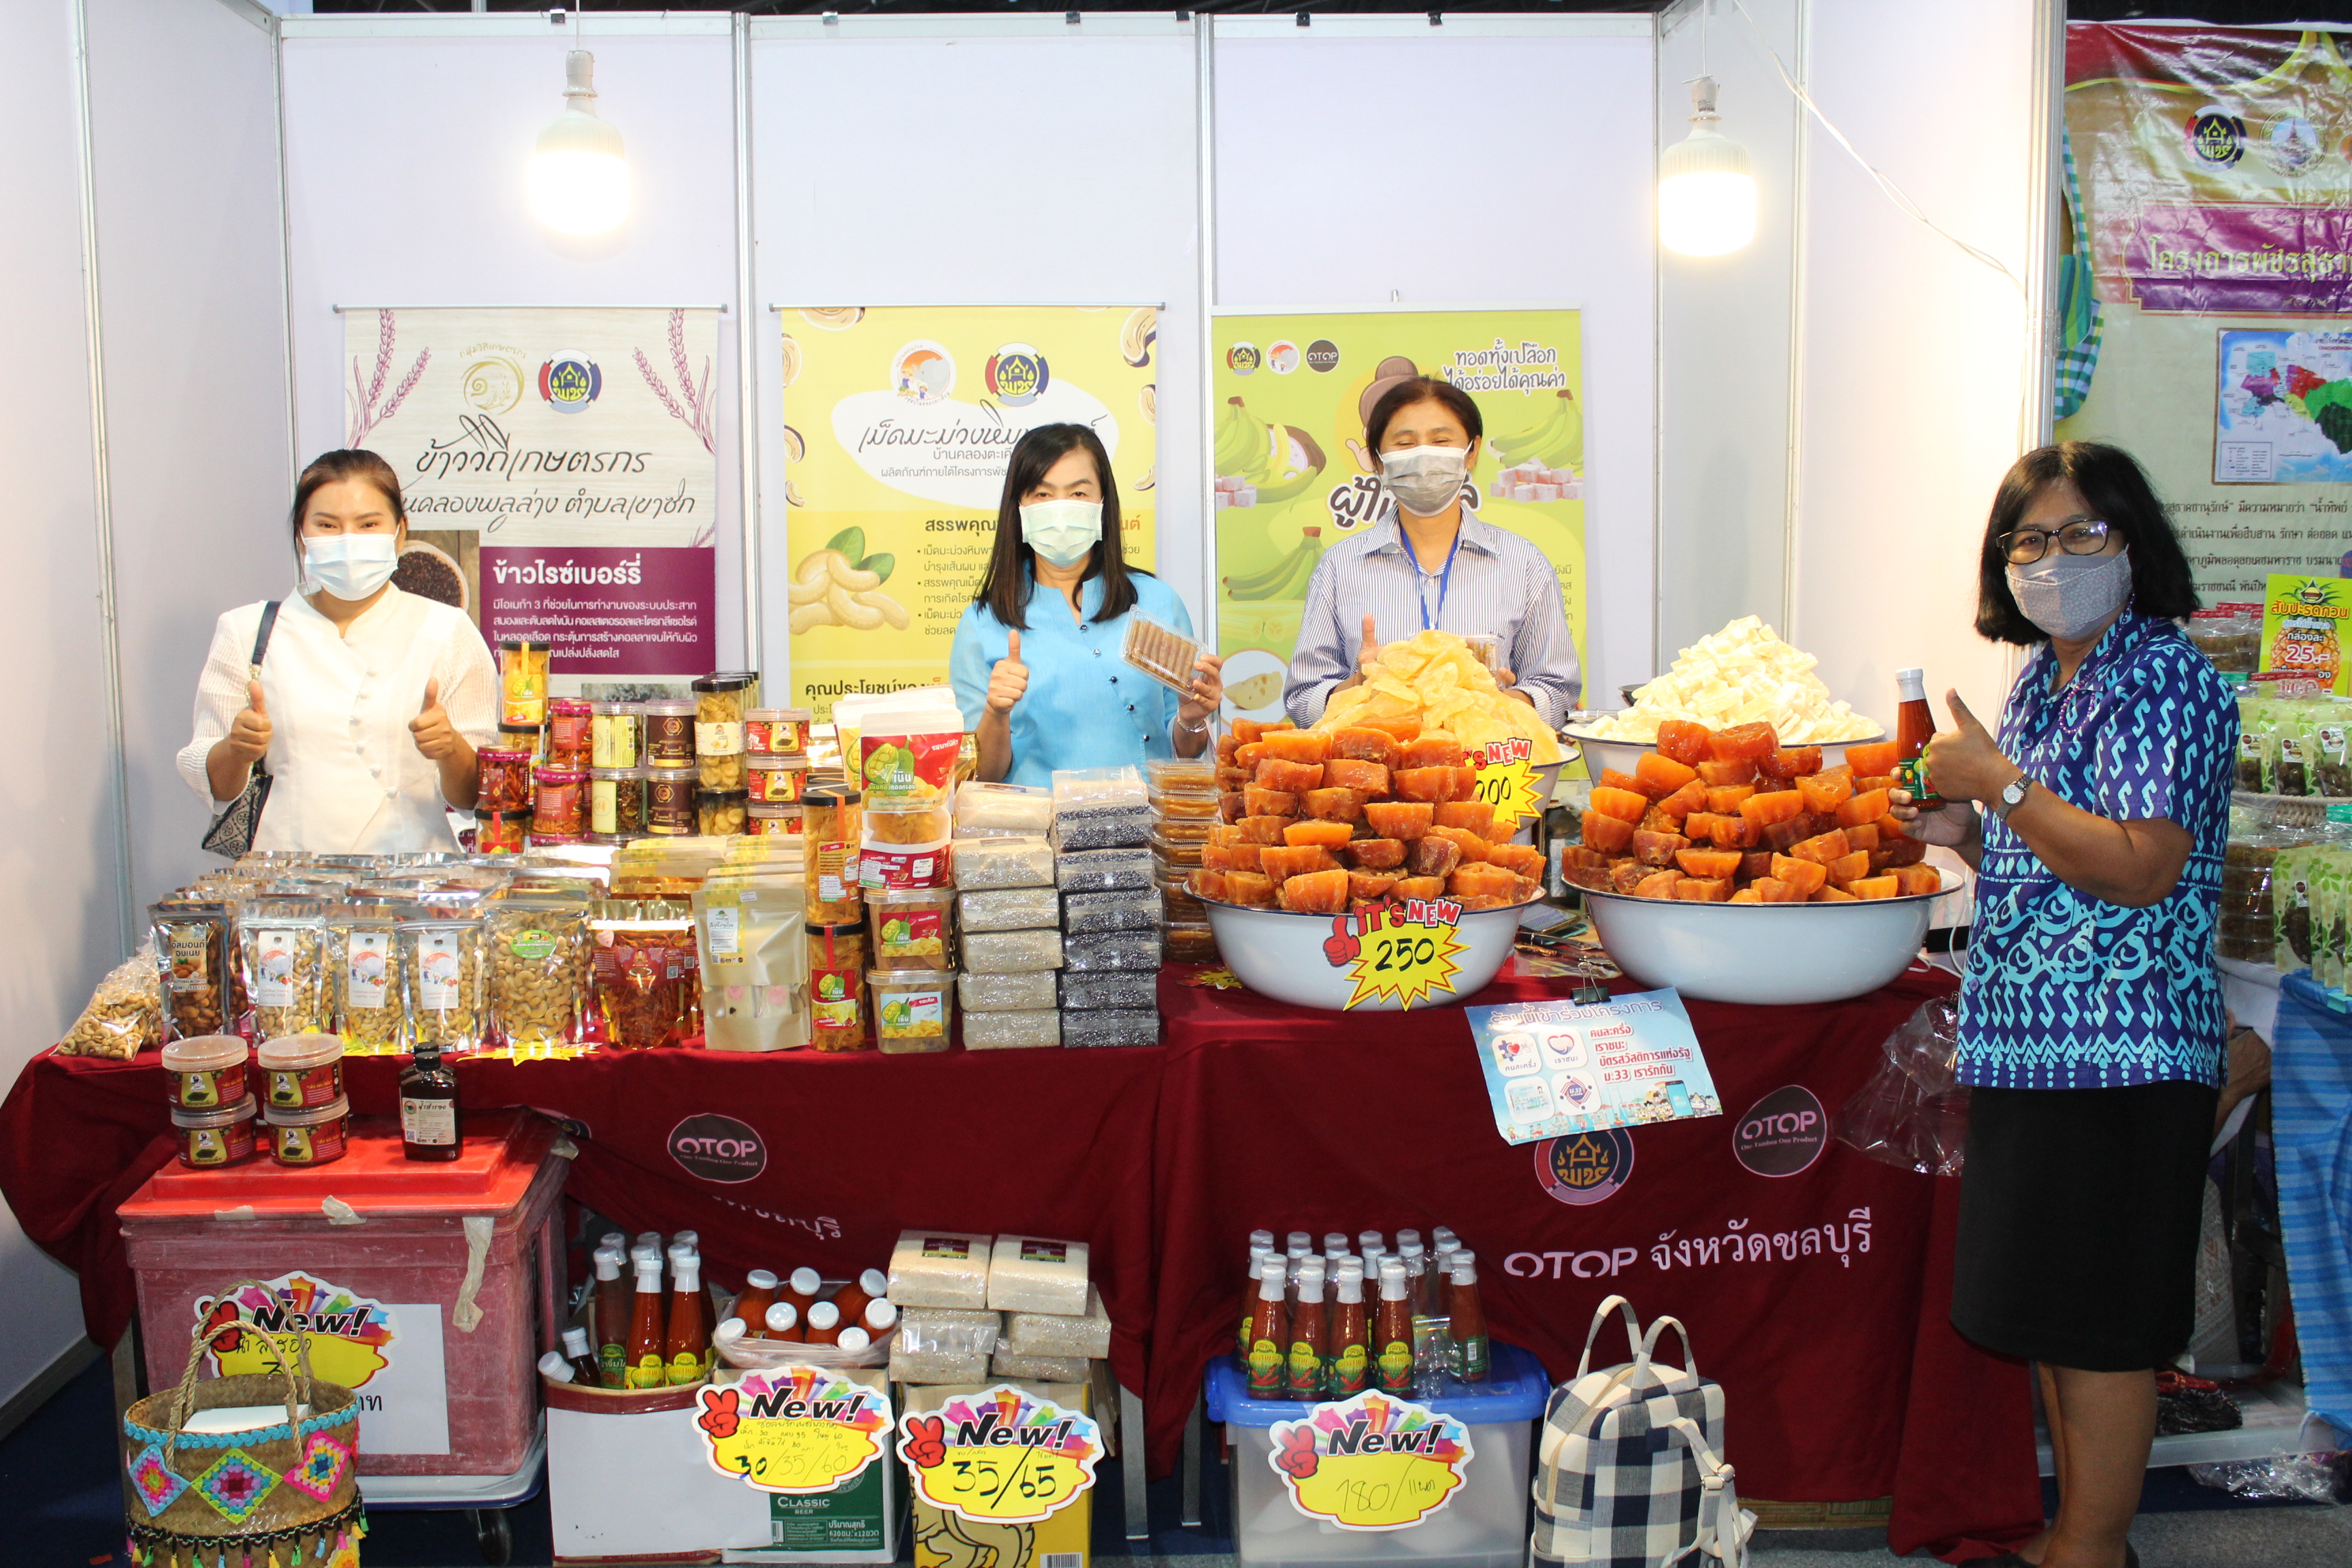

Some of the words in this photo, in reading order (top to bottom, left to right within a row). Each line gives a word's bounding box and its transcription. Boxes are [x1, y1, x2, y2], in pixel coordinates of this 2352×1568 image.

[1308, 352, 1337, 361] OTOP
[1455, 338, 1556, 365] ทอดทั้งเปลือก
[933, 448, 1012, 461] บ้านคลองตะเคี
[881, 466, 1007, 478] ผลิตภัณฑ์ภายใต้โครงการพัช
[402, 488, 558, 533] นคลองพลูล่าง
[925, 518, 998, 536] สรรพคุณ
[2178, 523, 2275, 539] ดำเนินงานเพื่อสืบสาน
[924, 544, 994, 556] เม็ดมะม่วงหิมพา
[493, 553, 642, 585] ข้าวไรซ์เบอร์รี่
[924, 576, 983, 589] สรรพคุณเม็ด
[493, 599, 532, 610] มีโอเมก้า
[534, 600, 541, 610] 3
[924, 608, 962, 620] เม็ดมะม่ว
[2270, 599, 2349, 620] สับปะรดกวน
[2287, 631, 2324, 642] กล่องละ
[1486, 738, 1533, 766] NEW
[1406, 898, 1464, 928] NEW
[1374, 938, 1435, 972] 250
[1590, 1022, 1632, 1039] คนละครึ่ง
[1595, 1041, 1626, 1053] เราชนะ
[1505, 1059, 1537, 1072] คนละครึ่ง
[1554, 1056, 1579, 1064] เราชนะ
[1599, 1047, 1692, 1067] บัตรสวัสดิการแห่งรัฐ
[1634, 1064, 1674, 1079] เรารักกัน
[1742, 1111, 1817, 1140] OTOP
[676, 1137, 757, 1158] OTOP
[1504, 1247, 1637, 1279] OTOP
[1650, 1206, 1873, 1269] จังหวัดชลบุรี
[251, 1298, 374, 1337] New!
[748, 1386, 870, 1424] New!
[953, 1411, 1078, 1450] New!
[1326, 1420, 1447, 1458] New!
